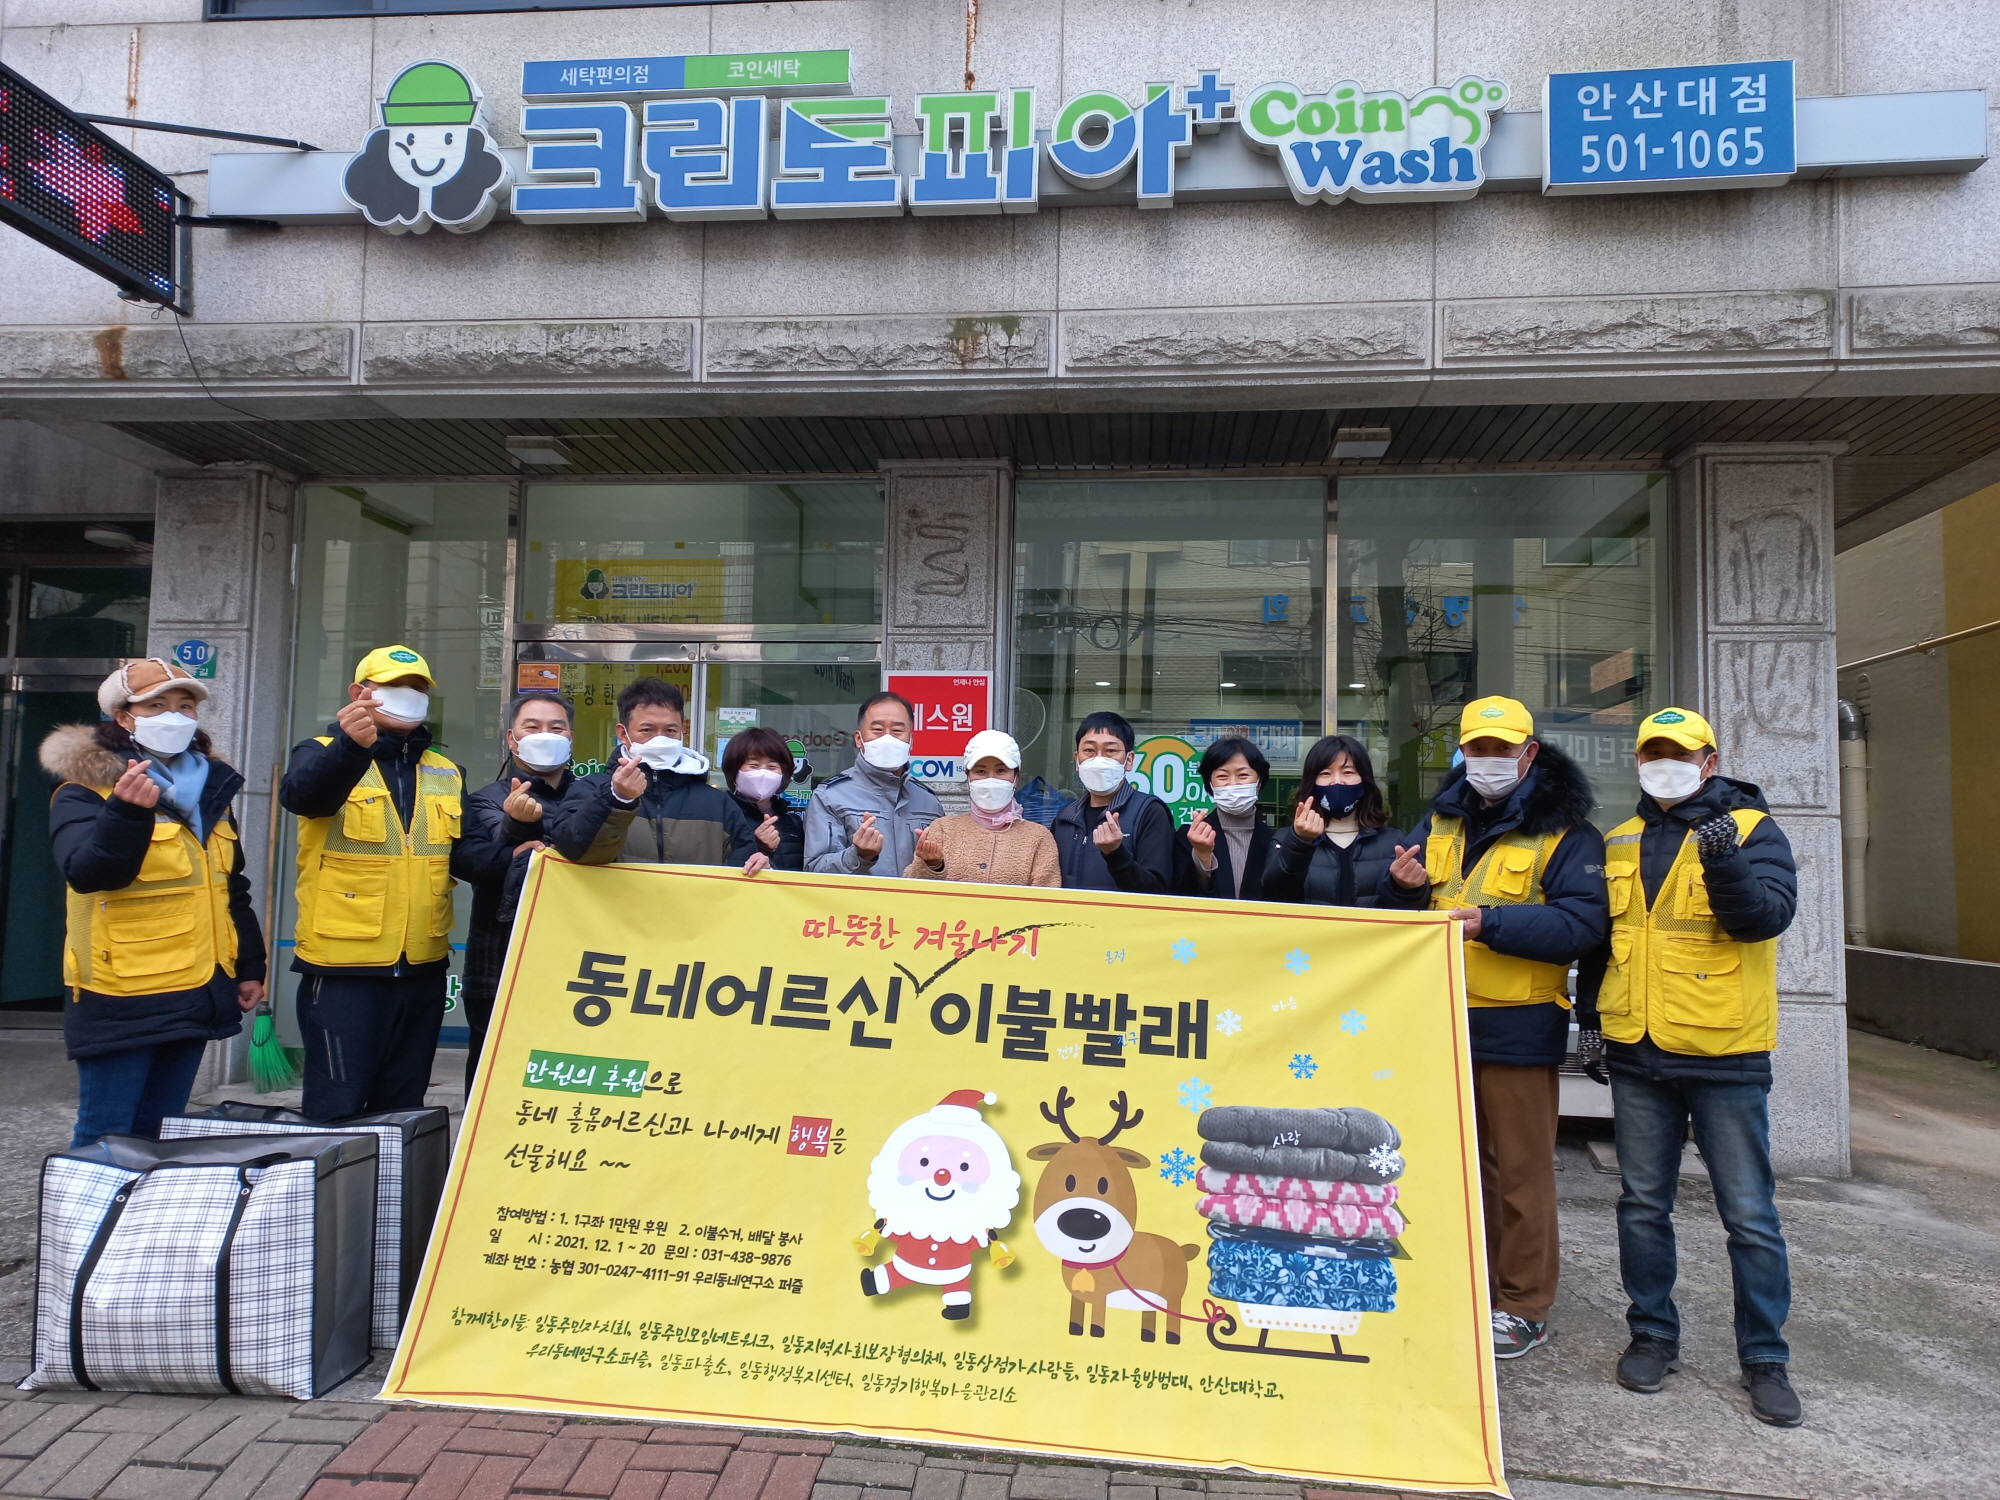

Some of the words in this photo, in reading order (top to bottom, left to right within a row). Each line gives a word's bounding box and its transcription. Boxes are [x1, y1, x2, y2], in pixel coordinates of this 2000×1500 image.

[559, 63, 650, 87] 세탁편의점
[727, 59, 801, 80] 코인세탁
[1250, 89, 1406, 138] Coin
[1290, 139, 1477, 187] Wash
[1580, 126, 1765, 174] 501-1065
[182, 645, 206, 661] 50
[802, 914, 900, 950] 따뜻한
[913, 920, 1039, 959] 겨울나기
[566, 951, 903, 1050] 동네어르신
[930, 983, 1209, 1068] 이불빨래
[526, 1059, 598, 1087] 만원의
[602, 1064, 683, 1095] 후원으로
[515, 1099, 559, 1126] 동네
[566, 1101, 693, 1138] 홀몸어르신과
[703, 1120, 781, 1145] 나에게
[790, 1123, 847, 1156] 행복을
[1272, 1129, 1302, 1149] 사랑
[504, 1143, 588, 1173] 선물해요
[489, 1228, 502, 1243] 일
[528, 1232, 543, 1245] 시
[554, 1234, 589, 1250] 2021.
[594, 1238, 612, 1252] 12.
[617, 1241, 624, 1253] 1
[639, 1243, 656, 1256] 20
[663, 1244, 689, 1260] 문의
[701, 1248, 792, 1267] 031-438-9876
[496, 1205, 548, 1225] 참여방법
[559, 1212, 569, 1225] 1.
[574, 1213, 605, 1229] 1구좌
[609, 1217, 641, 1235] 1만원
[643, 1219, 668, 1237] 후원
[678, 1223, 691, 1237] 2.
[694, 1225, 744, 1243] 이불수거,
[747, 1229, 775, 1246] 배달
[777, 1231, 804, 1247] 봉사
[483, 1251, 510, 1266] 계좌
[512, 1254, 537, 1271] 번호
[549, 1258, 575, 1276] 농협
[577, 1261, 690, 1283] 301-0247-4111-91
[693, 1271, 775, 1289] 우리동네연구소
[778, 1278, 804, 1294] 퍼즐
[526, 1343, 652, 1369] 우리동네연구소퍼즐,
[660, 1352, 732, 1377] 일동파출소,
[739, 1360, 854, 1388] 일동행정복지센터,
[861, 1372, 1018, 1404] 일동경기행복마을관리소
[535, 1314, 632, 1337] 일동주민자치회,
[639, 1320, 775, 1350] 일동주민모임네트워크,
[781, 1334, 947, 1368] 일동지역사회보장협의체,
[953, 1351, 1080, 1382] 일동상점가사람들,
[1086, 1363, 1193, 1391] 일동자율방범대,
[1199, 1374, 1285, 1400] 안산대학교,
